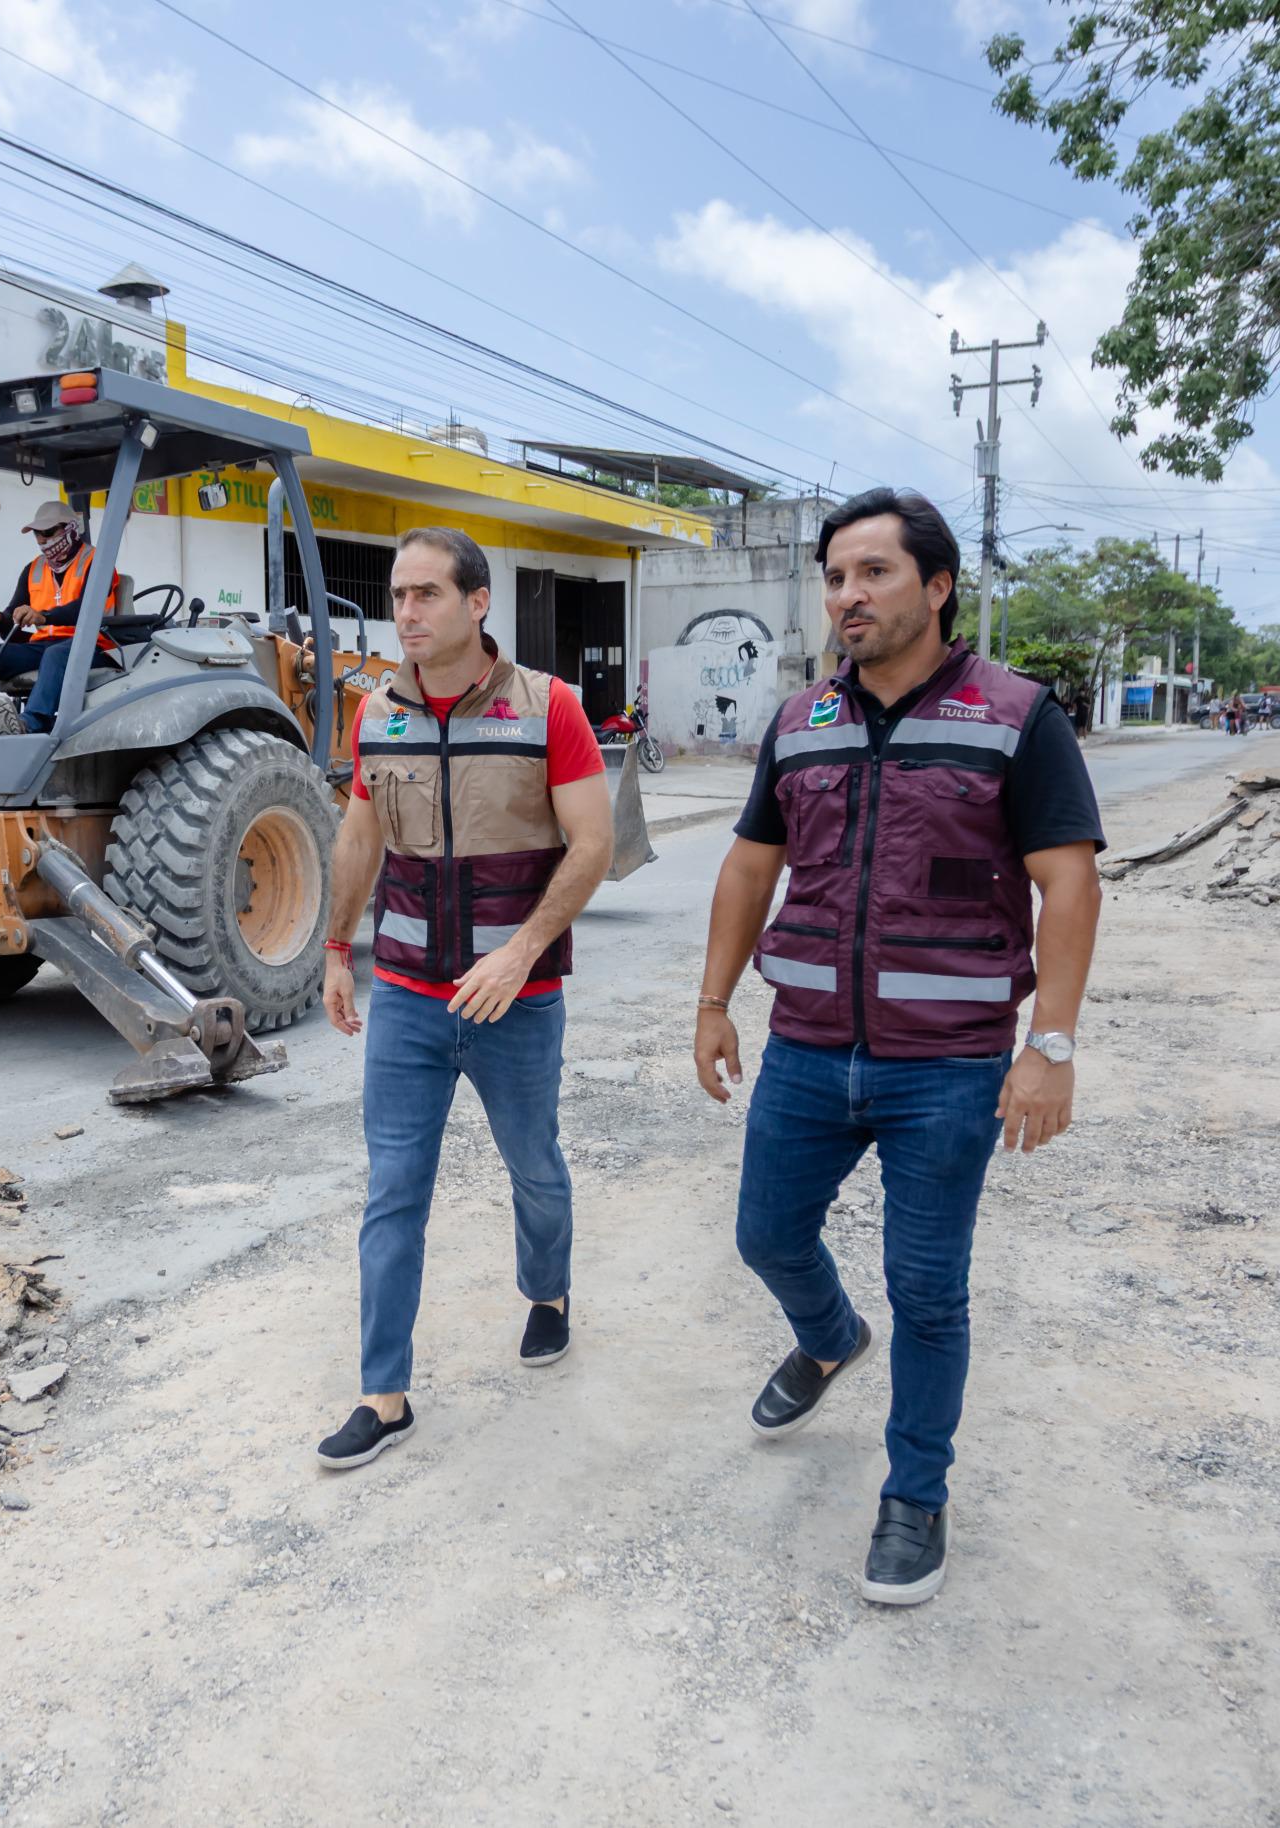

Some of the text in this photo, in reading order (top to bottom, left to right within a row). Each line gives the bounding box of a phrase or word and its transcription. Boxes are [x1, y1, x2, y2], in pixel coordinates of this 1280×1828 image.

[312, 494, 339, 521] SOL
[937, 707, 987, 720] TULUM
[475, 726, 524, 737] TULUM
